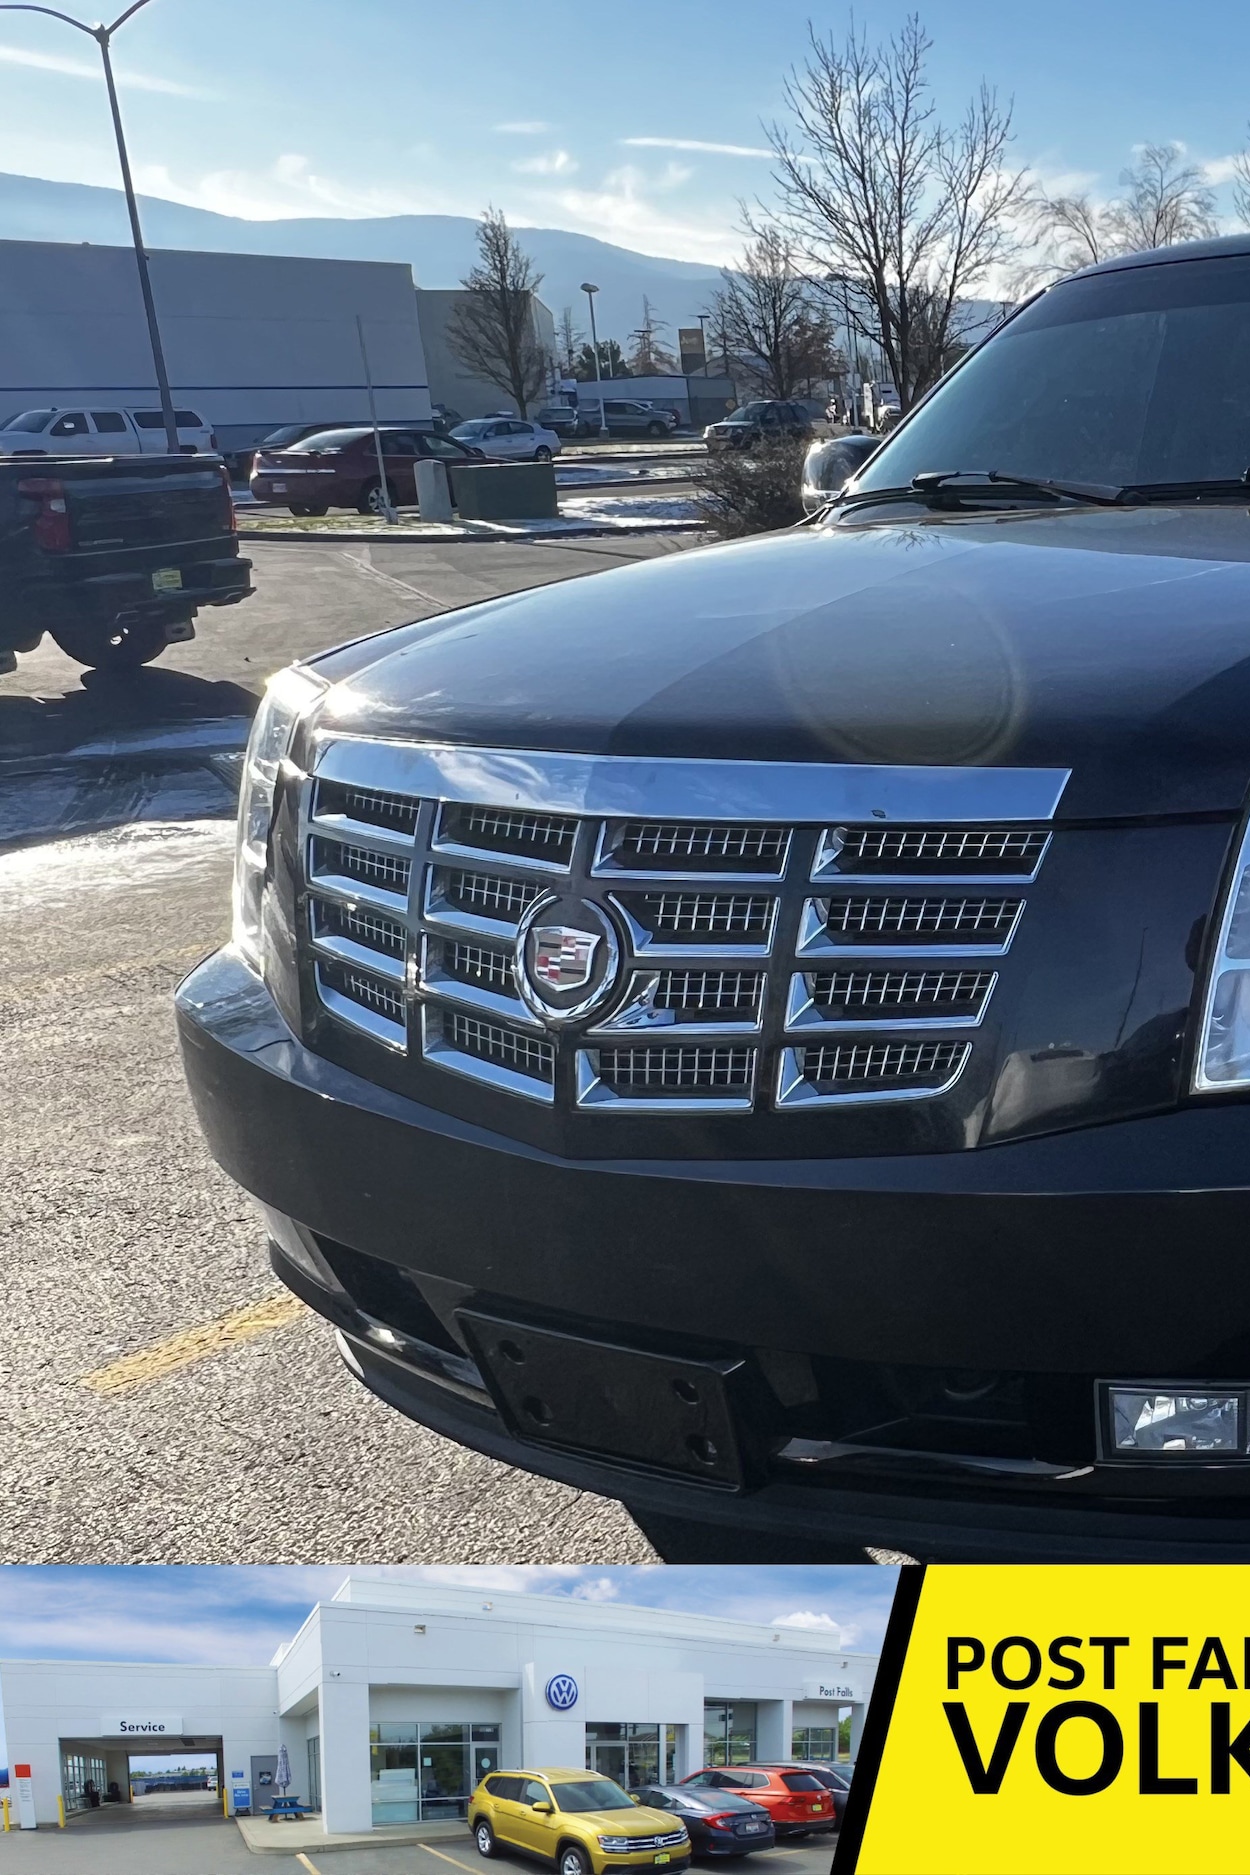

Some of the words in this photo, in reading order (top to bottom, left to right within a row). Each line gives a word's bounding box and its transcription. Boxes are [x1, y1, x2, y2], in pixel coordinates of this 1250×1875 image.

[819, 1686, 835, 1697] Post
[836, 1686, 853, 1698] Falls
[119, 1720, 166, 1732] Service
